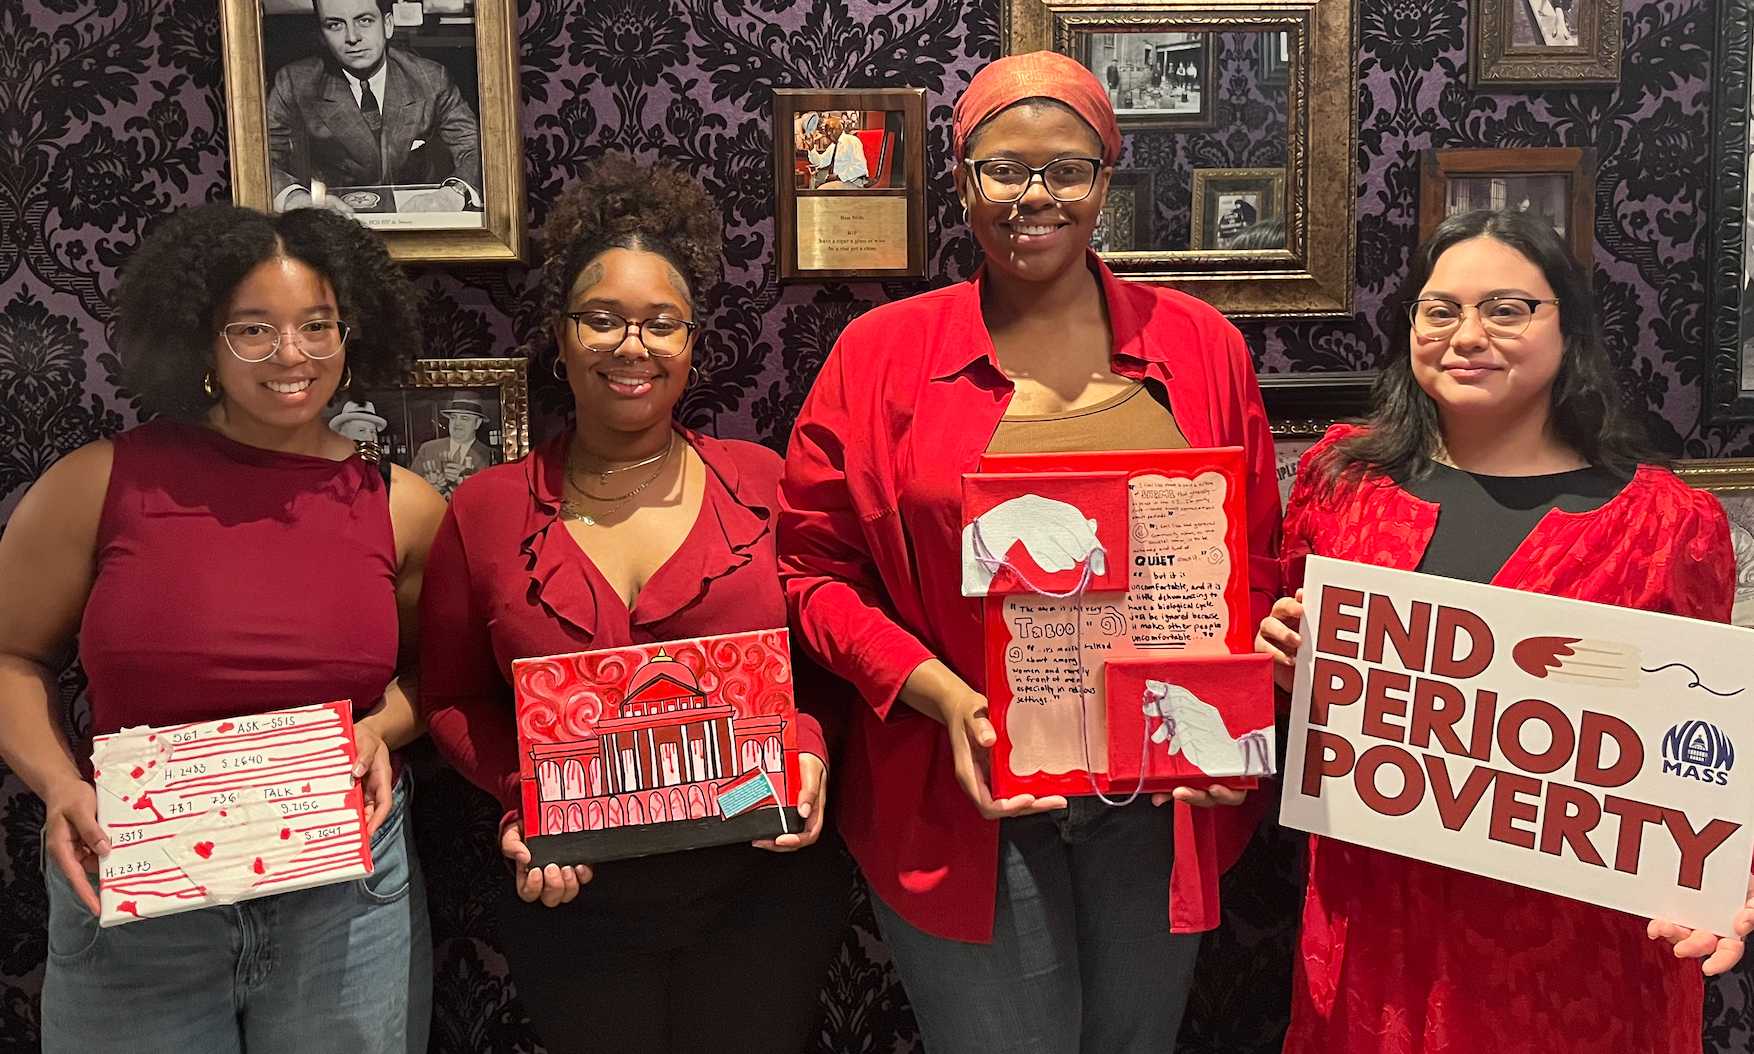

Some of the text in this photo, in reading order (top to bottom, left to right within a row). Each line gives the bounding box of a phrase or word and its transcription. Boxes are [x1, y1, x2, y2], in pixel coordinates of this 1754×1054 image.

[1316, 585, 1495, 679] END
[1309, 657, 1644, 788] PERIOD
[1662, 720, 1734, 771] NOW
[264, 788, 293, 799] TALK
[1663, 760, 1728, 785] MASS
[1301, 730, 1742, 891] POVERTY
